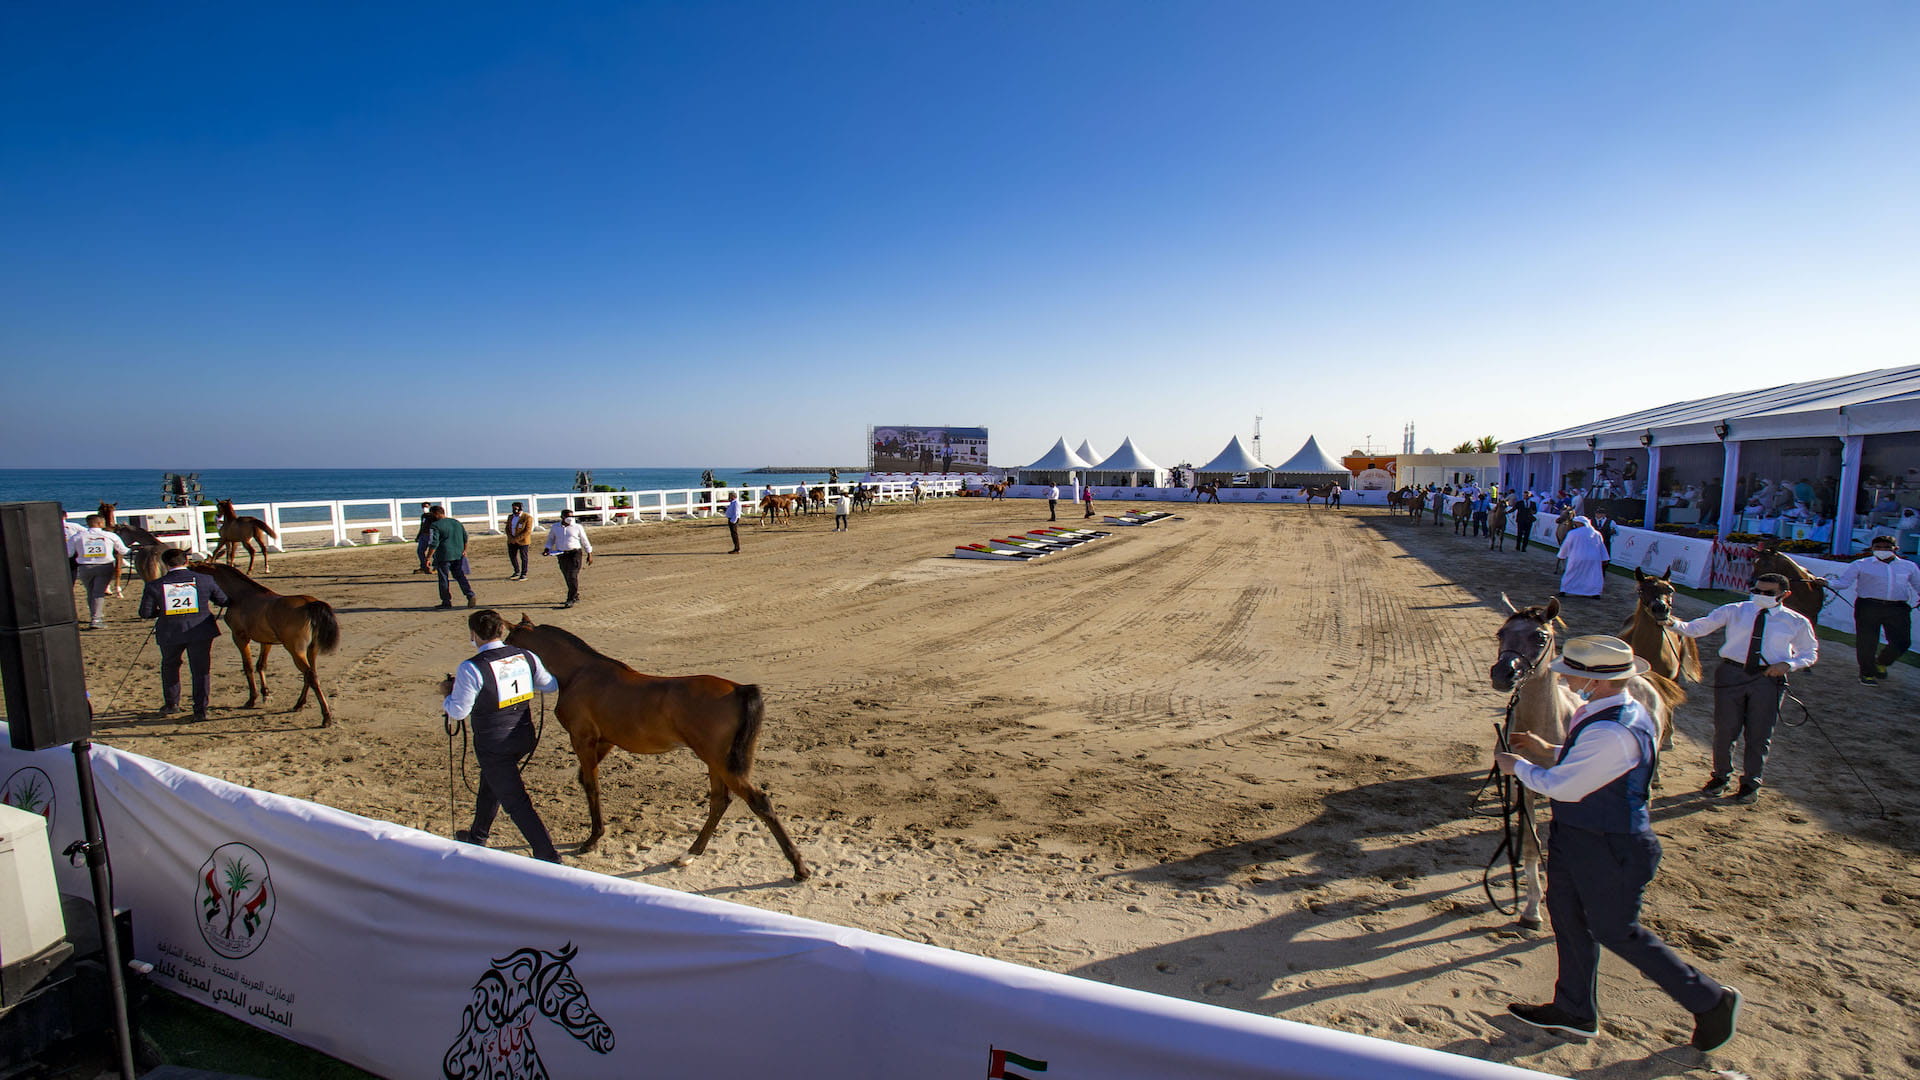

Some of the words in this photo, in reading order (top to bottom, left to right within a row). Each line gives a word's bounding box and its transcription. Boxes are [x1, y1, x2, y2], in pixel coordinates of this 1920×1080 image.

[88, 546, 102, 554] 23
[172, 597, 192, 608] 24
[511, 679, 518, 694] 1
[153, 958, 177, 979] كلباء
[212, 962, 239, 981] المتحدة
[178, 968, 211, 993] لمدينة
[241, 974, 265, 991] العربية
[212, 988, 247, 1009] البلدي
[248, 1003, 293, 1028] المجلس
